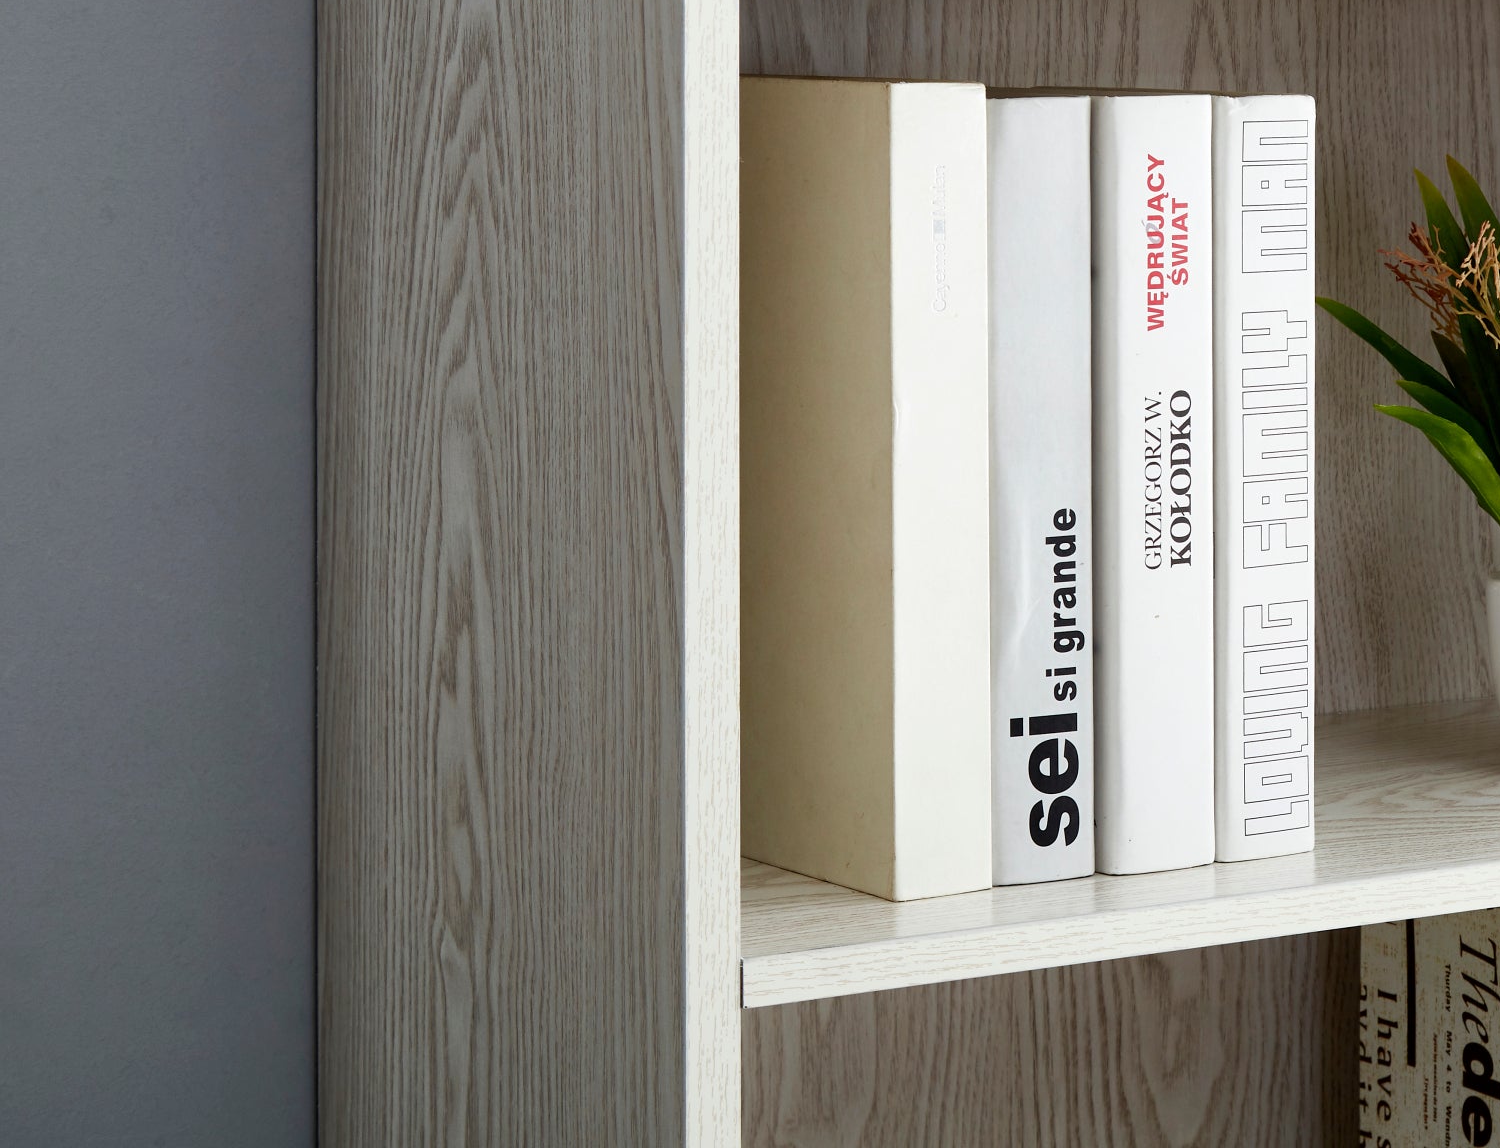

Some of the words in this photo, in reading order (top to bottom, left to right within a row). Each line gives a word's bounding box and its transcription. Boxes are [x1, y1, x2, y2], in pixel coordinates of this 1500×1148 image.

[1147, 154, 1169, 332] WĘDRUJĄCY
[1166, 197, 1189, 286] ŚWIAT
[1242, 119, 1308, 274] MAN
[1144, 390, 1163, 423] W.
[1242, 309, 1308, 569] FAMILY
[1144, 428, 1163, 571] GRZEGORZ
[1170, 389, 1192, 568] KOŁODKO
[1045, 508, 1085, 654] grande
[1045, 666, 1077, 702] si
[1243, 599, 1310, 837] LOVING
[1010, 712, 1080, 847] sei
[1377, 988, 1397, 1003] I
[1377, 1016, 1398, 1122] have
